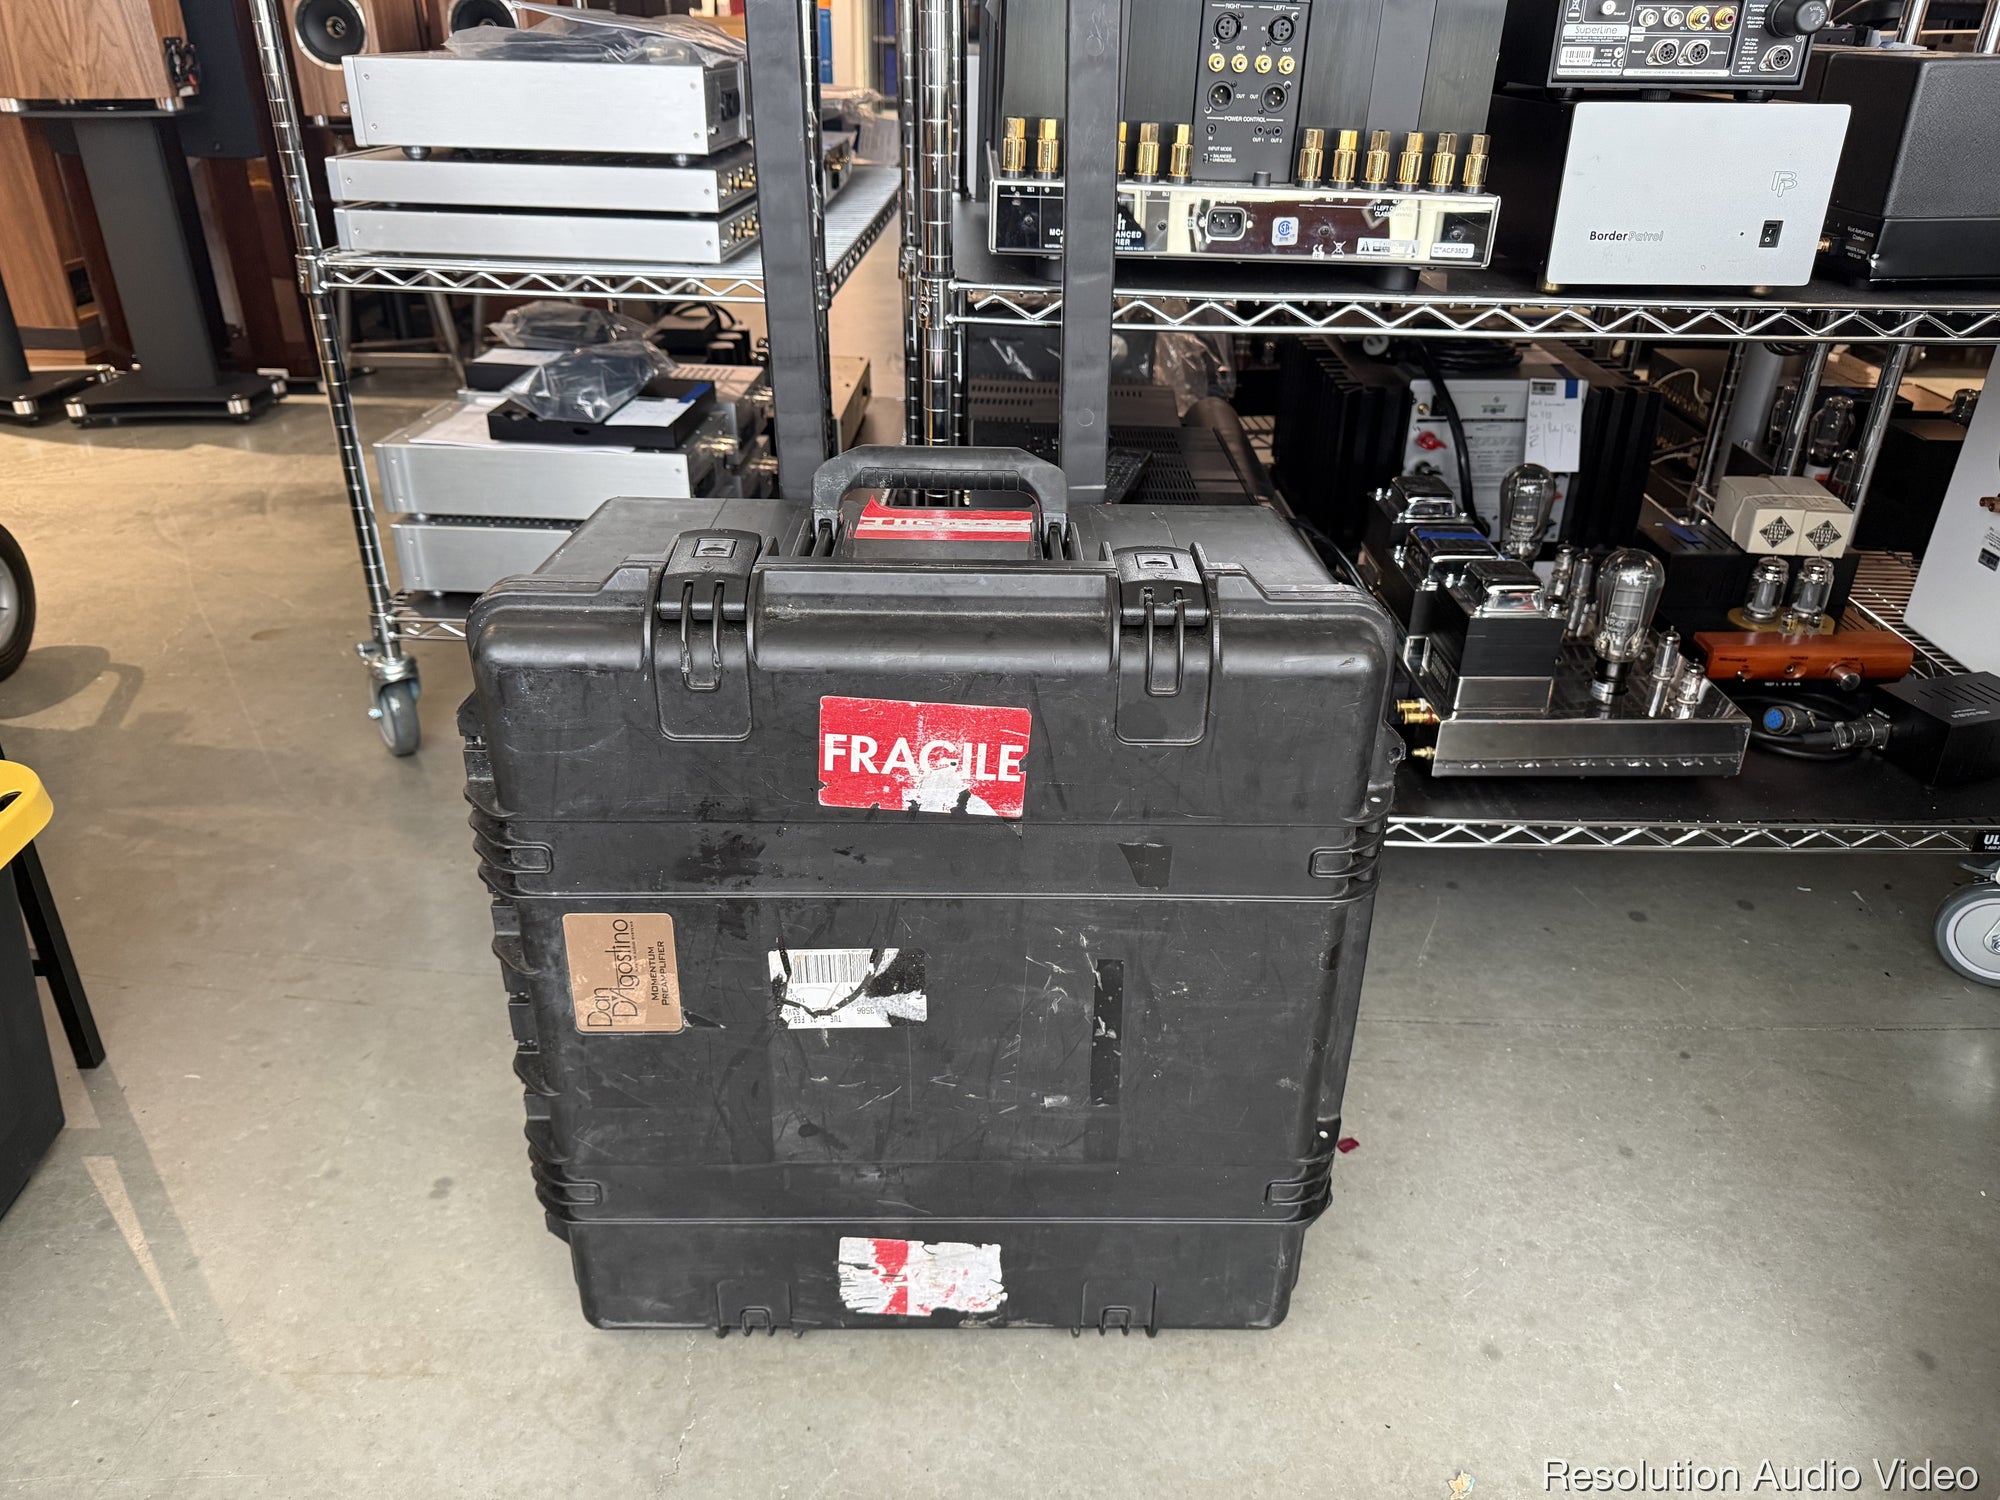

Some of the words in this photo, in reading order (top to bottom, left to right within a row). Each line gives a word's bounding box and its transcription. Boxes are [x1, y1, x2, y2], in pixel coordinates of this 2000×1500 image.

[1574, 26, 1618, 35] SuperLine
[1115, 230, 1142, 239] ANCED
[1589, 230, 1664, 242] BorderPatrol
[823, 733, 1024, 783] FRAGILE
[647, 946, 660, 1001] MOMENTUM
[657, 940, 670, 1006] PREAMPLIFIER
[587, 987, 612, 1027] Dan
